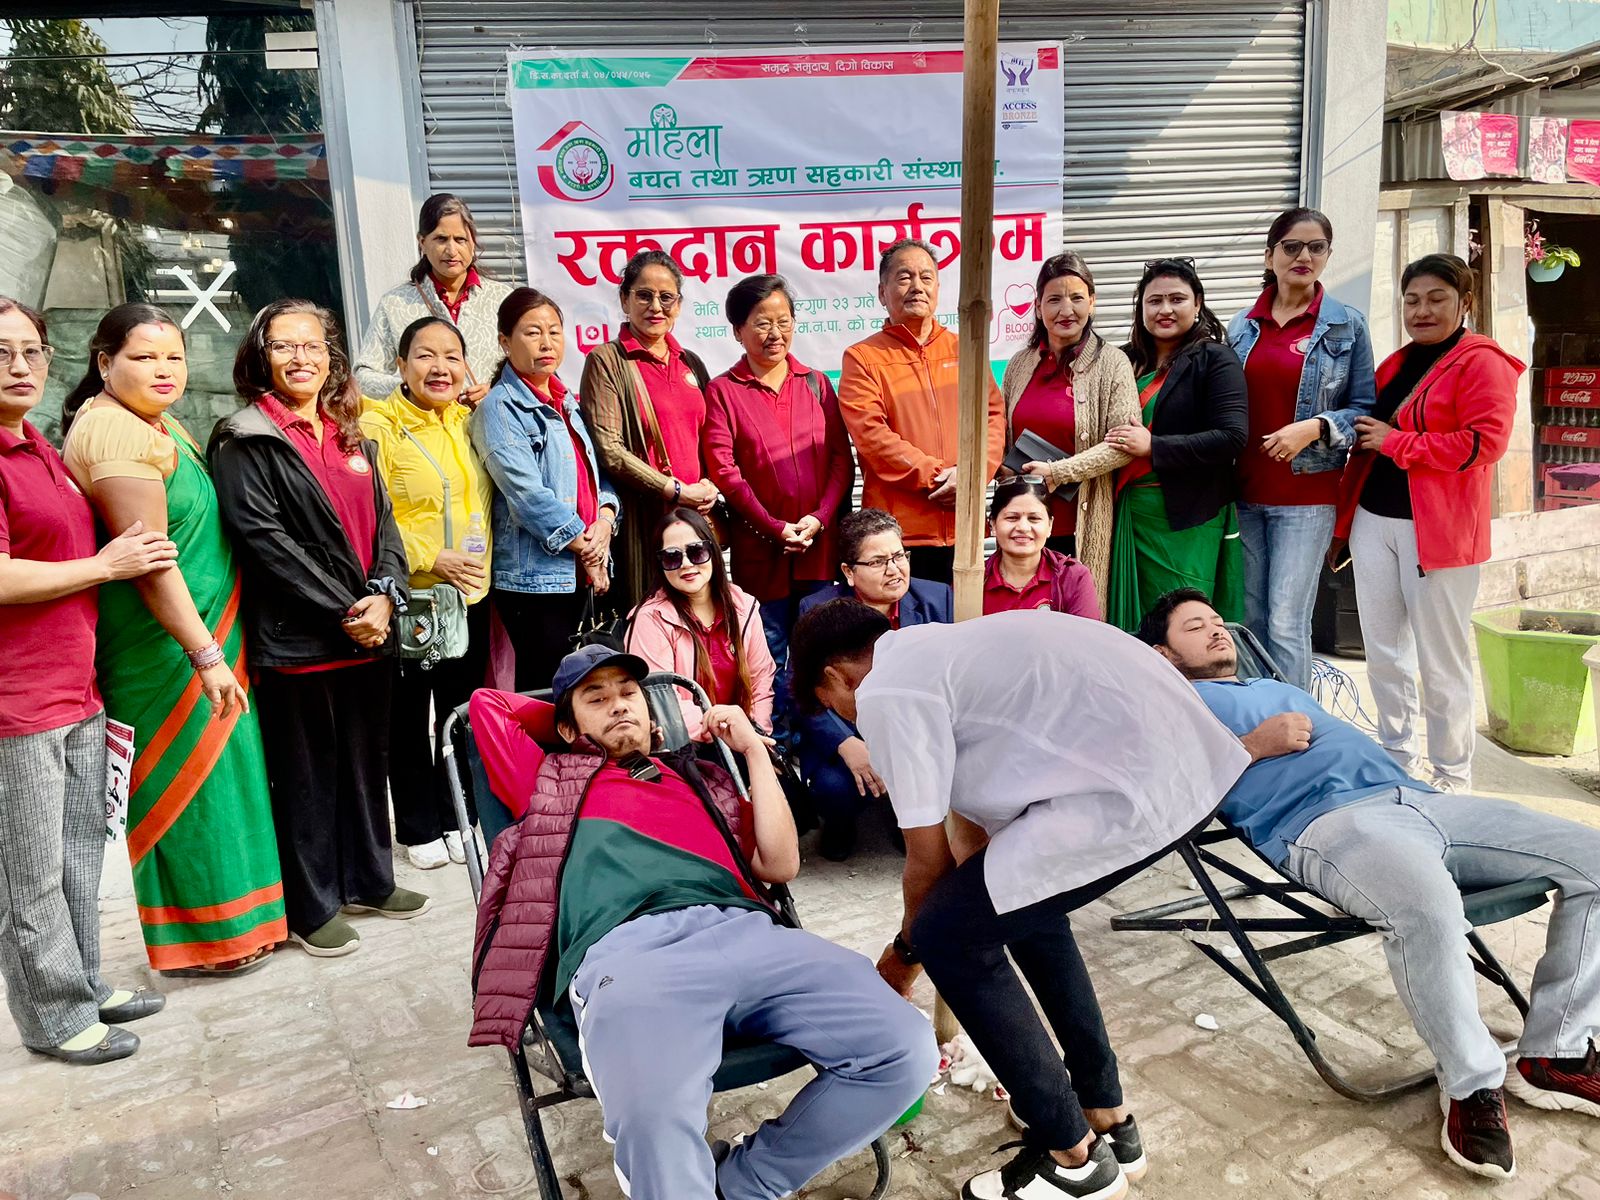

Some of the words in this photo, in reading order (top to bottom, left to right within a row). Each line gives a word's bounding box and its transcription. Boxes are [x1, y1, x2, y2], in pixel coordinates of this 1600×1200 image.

[761, 63, 790, 74] समृद्ध
[794, 62, 832, 74] समुदाय,
[836, 59, 858, 71] दिगो
[861, 59, 894, 70] विकास
[1002, 102, 1037, 111] ACCESS
[1002, 111, 1037, 120] BRONZE
[624, 122, 723, 168] महिला
[627, 170, 682, 189] बचत
[690, 168, 739, 188] तथा
[746, 167, 797, 187] ऋण
[805, 157, 894, 187] सहकारी
[901, 157, 962, 179] संस्था
[832, 297, 849, 311] २३
[853, 292, 876, 309] गते
[695, 325, 729, 339] स्थान
[793, 319, 842, 335] .म.न.पा.
[847, 314, 866, 331] को
[1005, 322, 1035, 333] BLOOD
